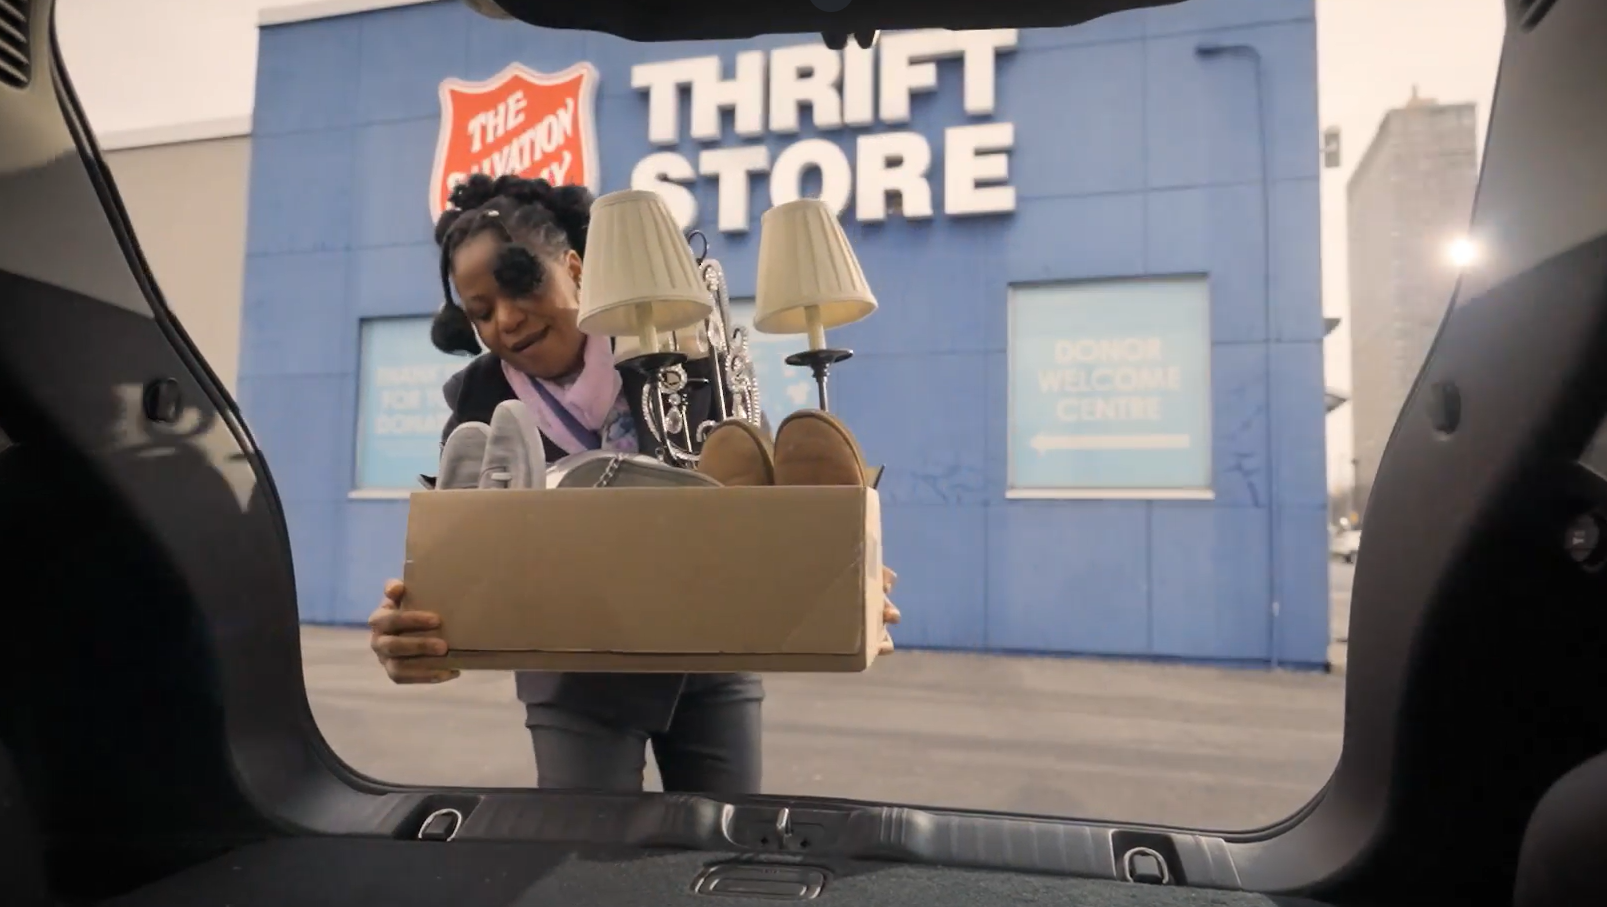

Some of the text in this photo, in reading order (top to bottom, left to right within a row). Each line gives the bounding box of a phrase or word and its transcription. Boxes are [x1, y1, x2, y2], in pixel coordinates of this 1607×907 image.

[631, 28, 1019, 147] THRIFT
[467, 89, 527, 154] THE
[631, 122, 1018, 233] STORE
[1054, 337, 1162, 364] DONOR
[1038, 366, 1181, 393] WELCOME
[1056, 396, 1162, 422] CENTRE
